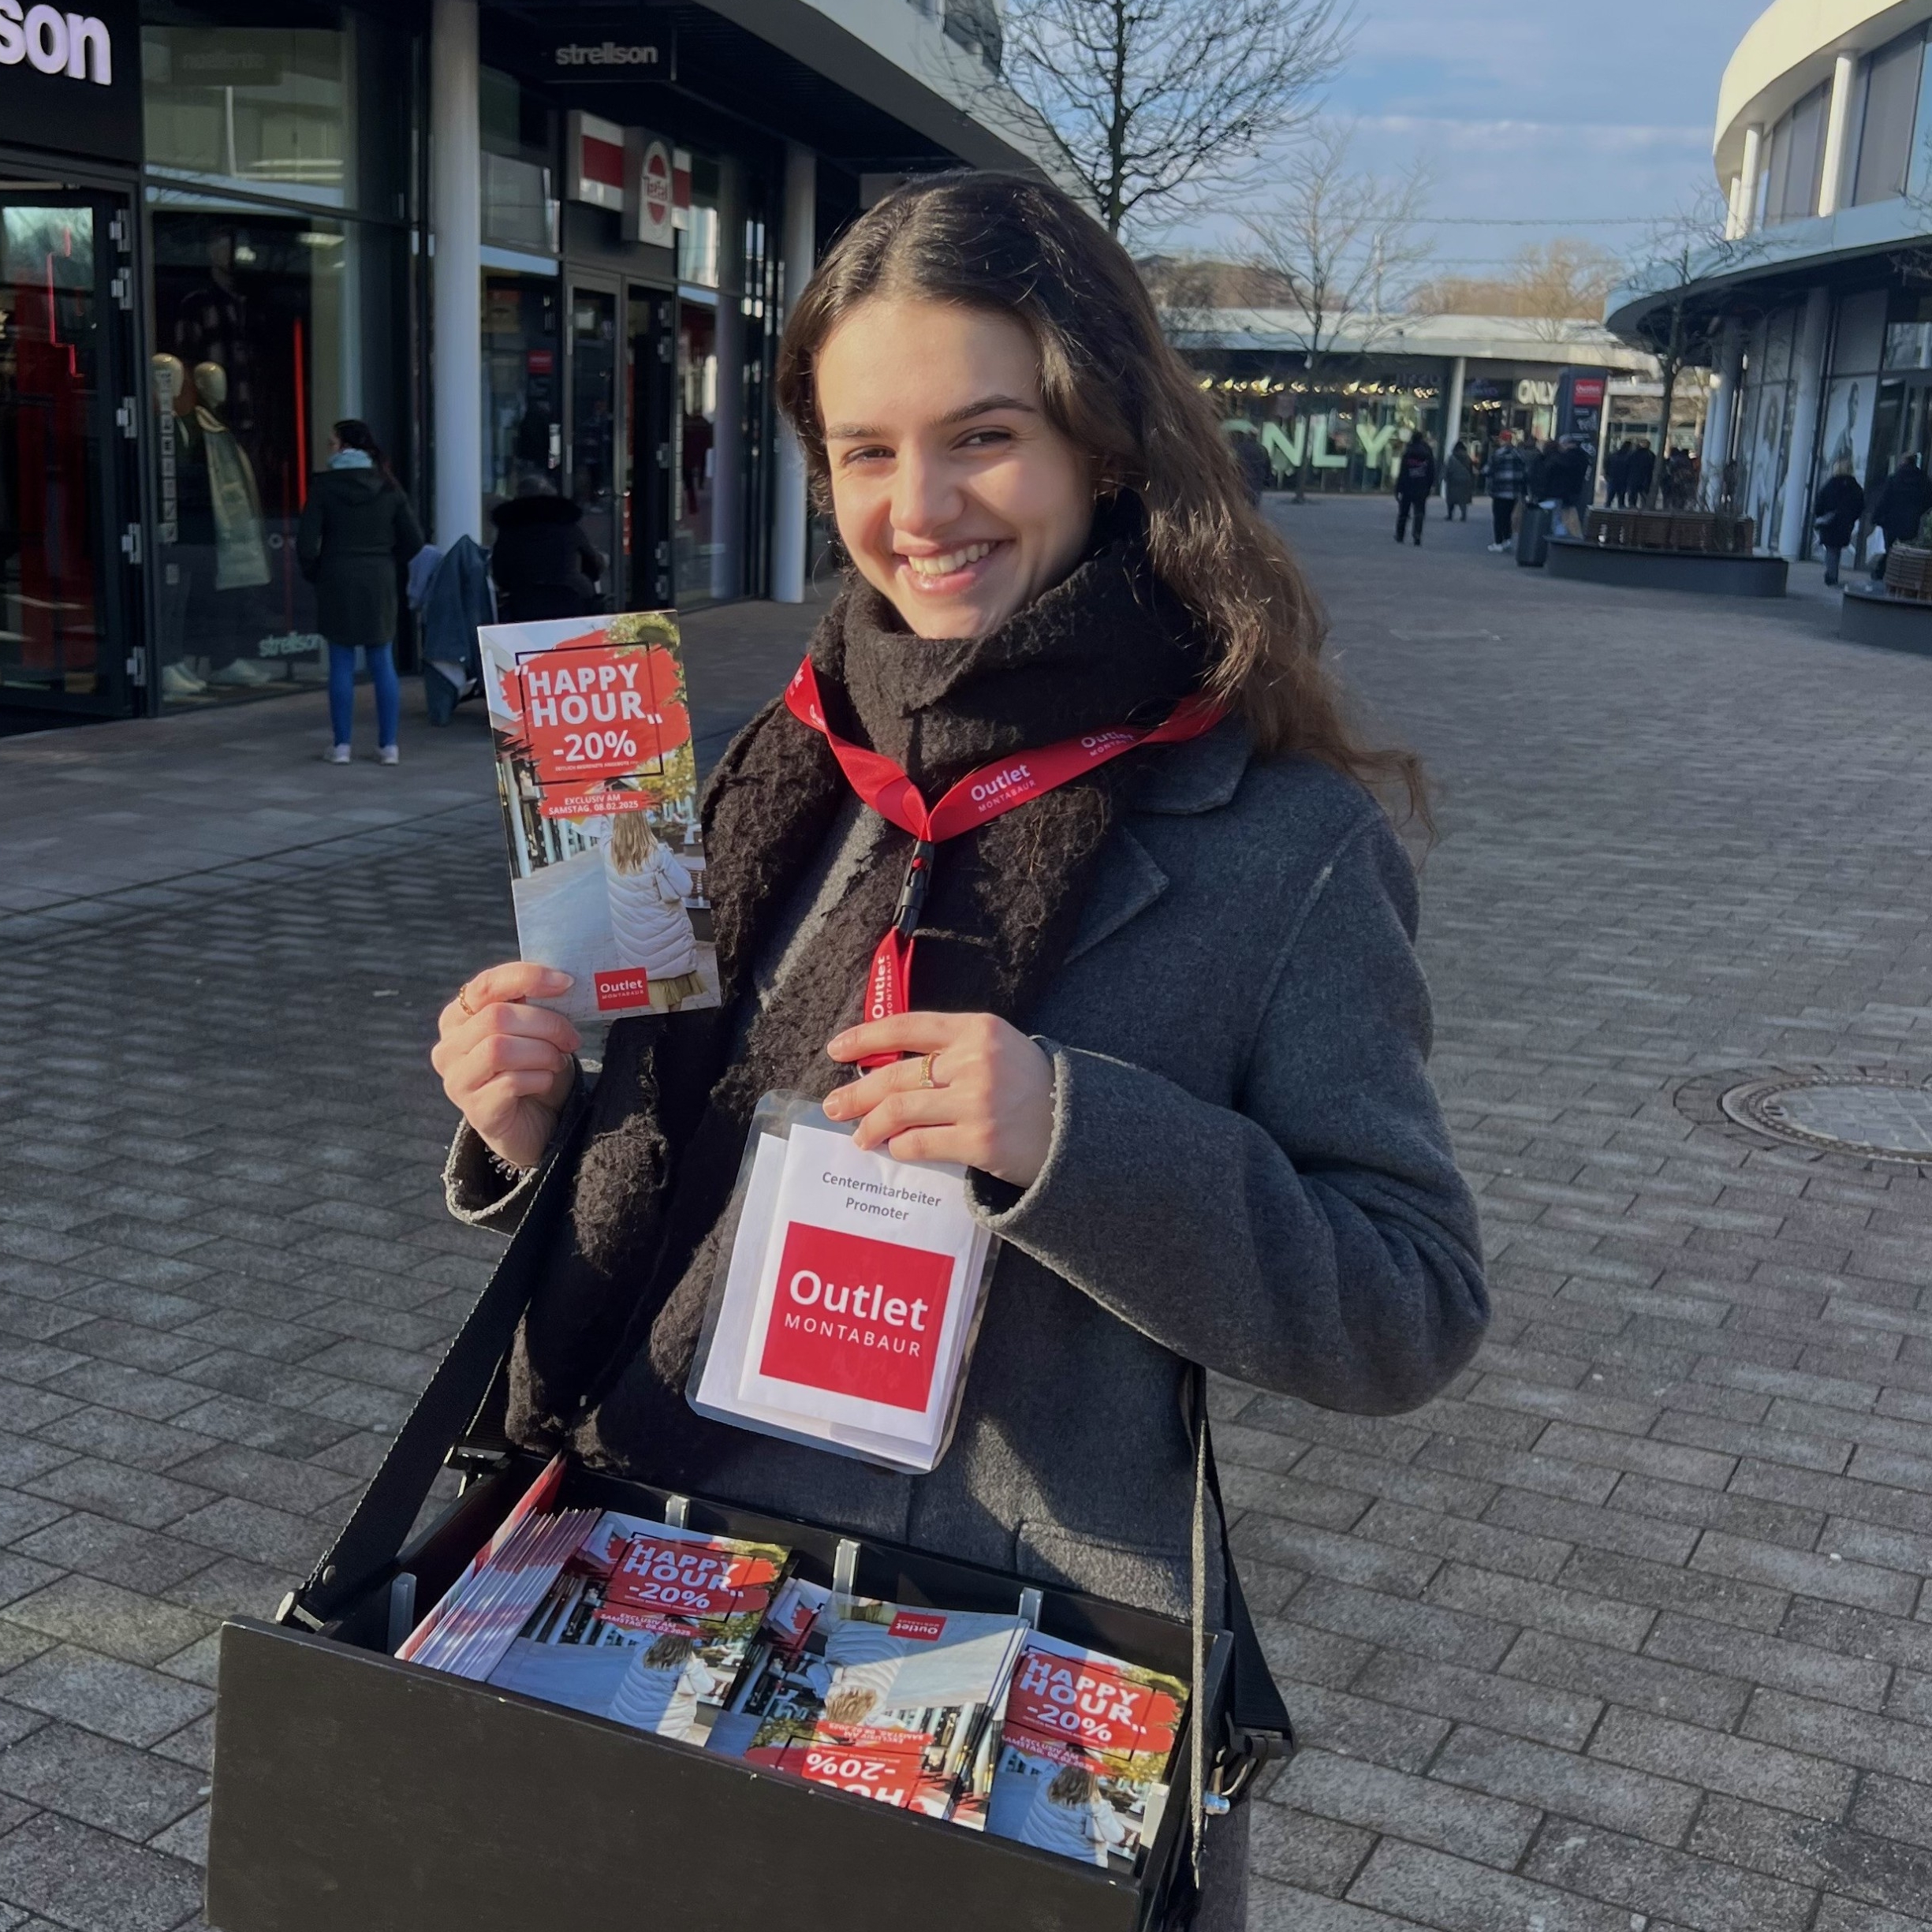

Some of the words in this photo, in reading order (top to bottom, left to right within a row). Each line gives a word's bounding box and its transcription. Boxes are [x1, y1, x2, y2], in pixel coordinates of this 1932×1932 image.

[555, 42, 658, 65] strellson
[1518, 379, 1557, 405] ONLY
[1222, 418, 1396, 469] NLY
[553, 729, 636, 762] -20%
[971, 764, 1031, 801] Outlet
[978, 780, 1036, 812] MONTABAUR
[565, 795, 605, 806] EXCLUSIV
[594, 800, 639, 811] 08.02.2025
[600, 979, 643, 993] Outlet
[872, 955, 885, 1019] Outlet
[822, 1171, 942, 1207] Centermitarbeiter
[845, 1196, 909, 1221] Promoter
[790, 1270, 928, 1332] Outlet
[785, 1313, 921, 1357] MONTABAUR
[629, 1583, 710, 1609] -20%
[895, 1623, 938, 1635] Outlet
[1027, 1704, 1112, 1742] -20%
[806, 1753, 896, 1781] -20%
